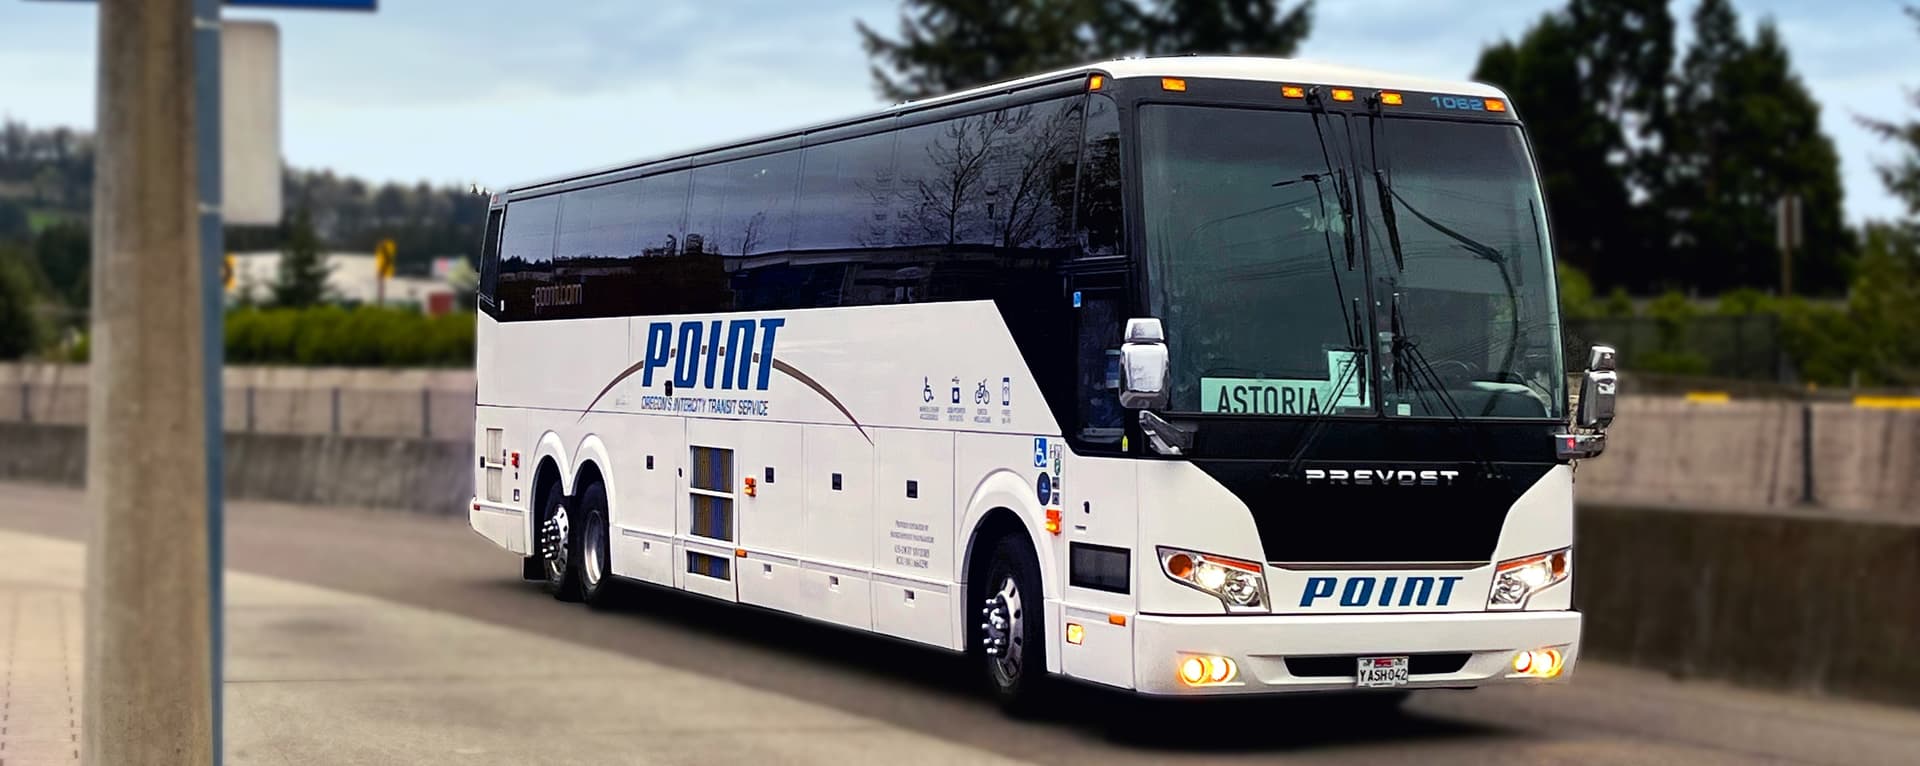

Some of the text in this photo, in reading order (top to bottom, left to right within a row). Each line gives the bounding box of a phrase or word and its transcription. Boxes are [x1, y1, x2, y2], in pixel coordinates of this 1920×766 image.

[1431, 95, 1484, 111] 1062
[642, 317, 786, 391] POINT
[673, 397, 706, 413] INTERCITY
[708, 398, 737, 414] TRANSIT
[738, 399, 769, 416] SERVICE
[1217, 385, 1321, 415] ASTORIA
[1304, 469, 1460, 487] PREVOST
[1298, 576, 1464, 607] POINT
